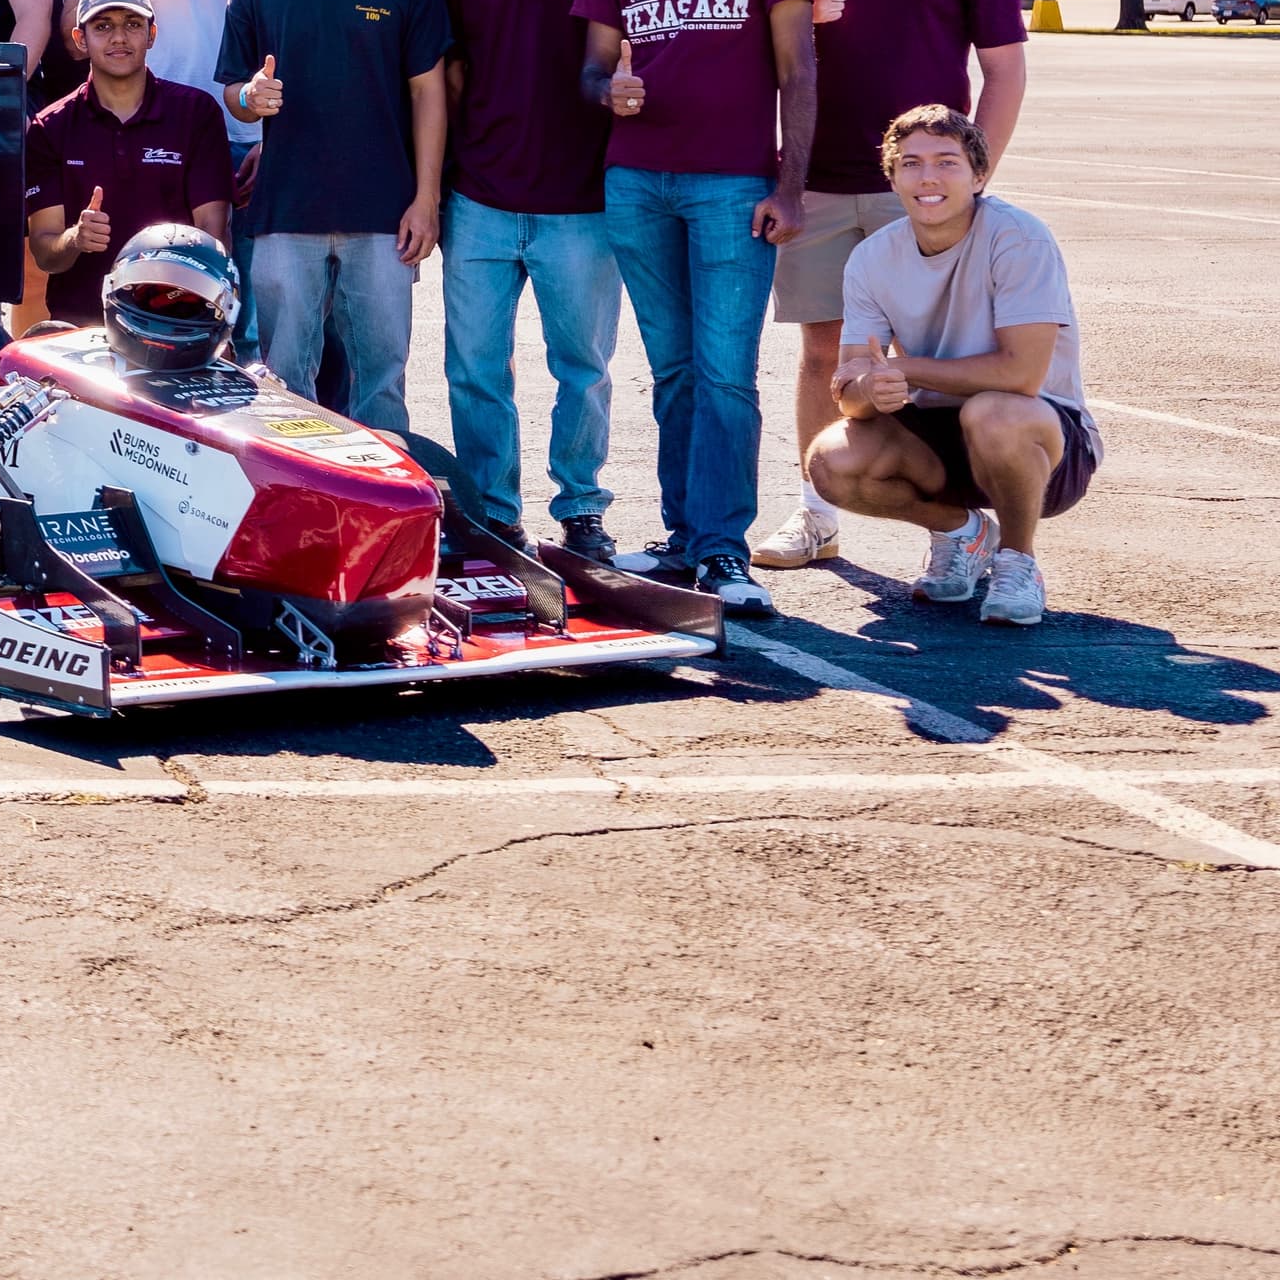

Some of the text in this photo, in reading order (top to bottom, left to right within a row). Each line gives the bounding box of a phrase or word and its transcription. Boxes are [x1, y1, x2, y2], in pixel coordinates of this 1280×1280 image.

[123, 432, 161, 458] BURNS
[189, 507, 230, 530] SORACOM
[74, 548, 131, 564] brembo
